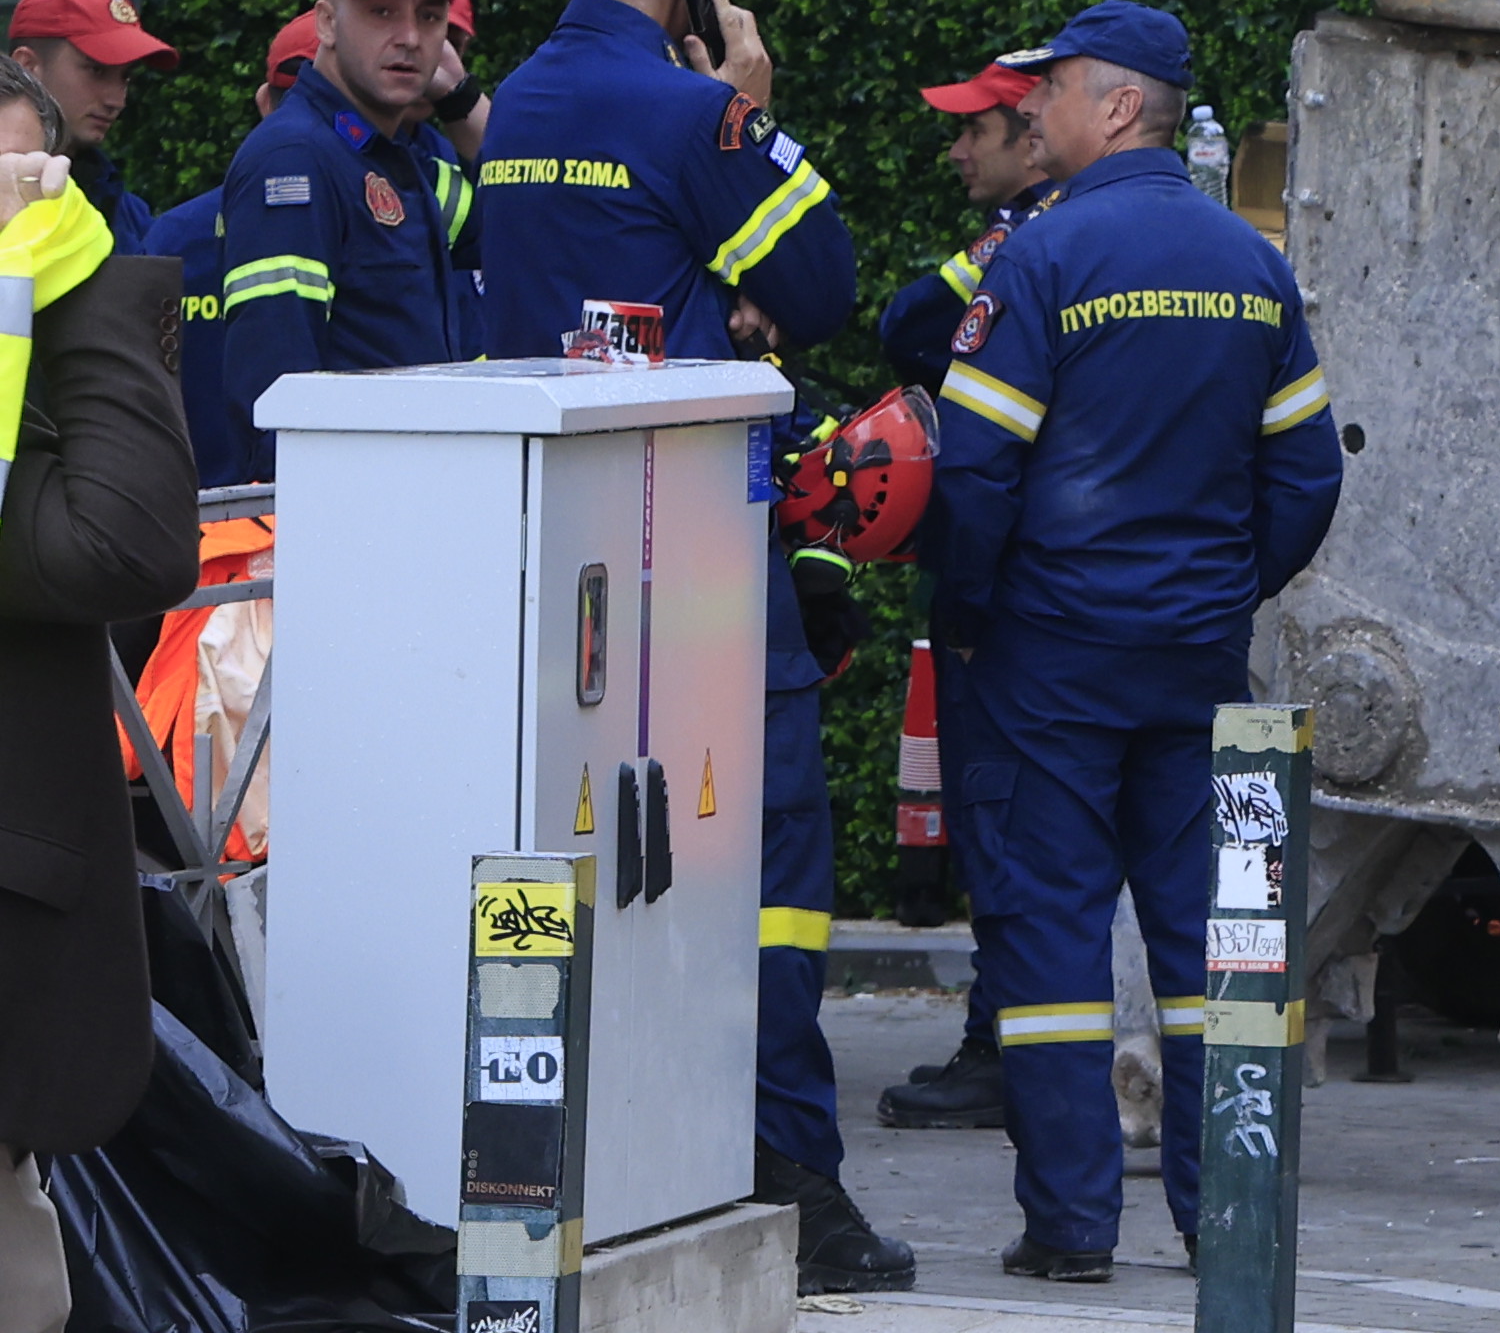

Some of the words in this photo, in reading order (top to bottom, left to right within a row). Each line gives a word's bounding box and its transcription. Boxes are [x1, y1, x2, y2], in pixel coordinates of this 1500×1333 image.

[563, 159, 630, 189] ΣΩΜΑ
[1060, 289, 1237, 334] ΠΥΡΟΣΒΕΣΤΙΚΟ
[466, 1180, 556, 1199] DISKONNEKT
